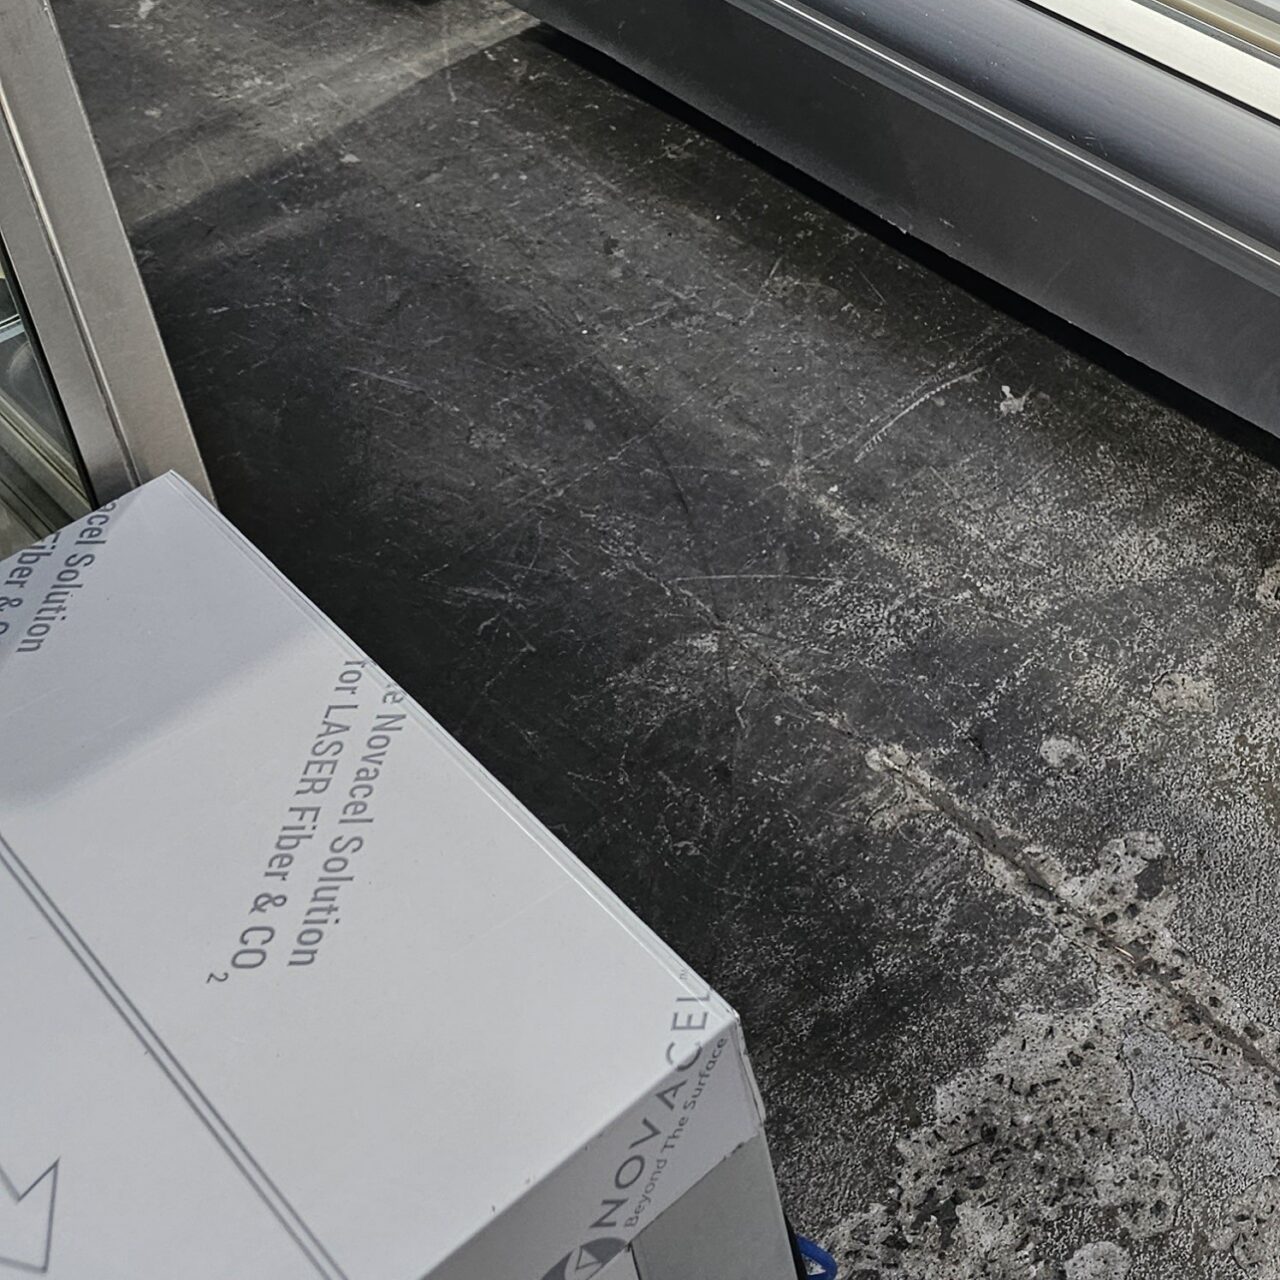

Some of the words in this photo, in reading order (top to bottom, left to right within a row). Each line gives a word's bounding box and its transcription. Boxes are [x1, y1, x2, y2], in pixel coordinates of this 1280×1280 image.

[16, 552, 95, 652] Solution
[295, 704, 359, 796] LASER
[338, 714, 407, 825] Novacel
[263, 806, 322, 881] Fiber
[249, 892, 288, 915] &
[287, 834, 364, 966] Solution
[589, 993, 711, 1230] NOVACEL
[623, 1158, 667, 1229] Beyond
[660, 1115, 689, 1153] The
[683, 1036, 728, 1110] Surface
